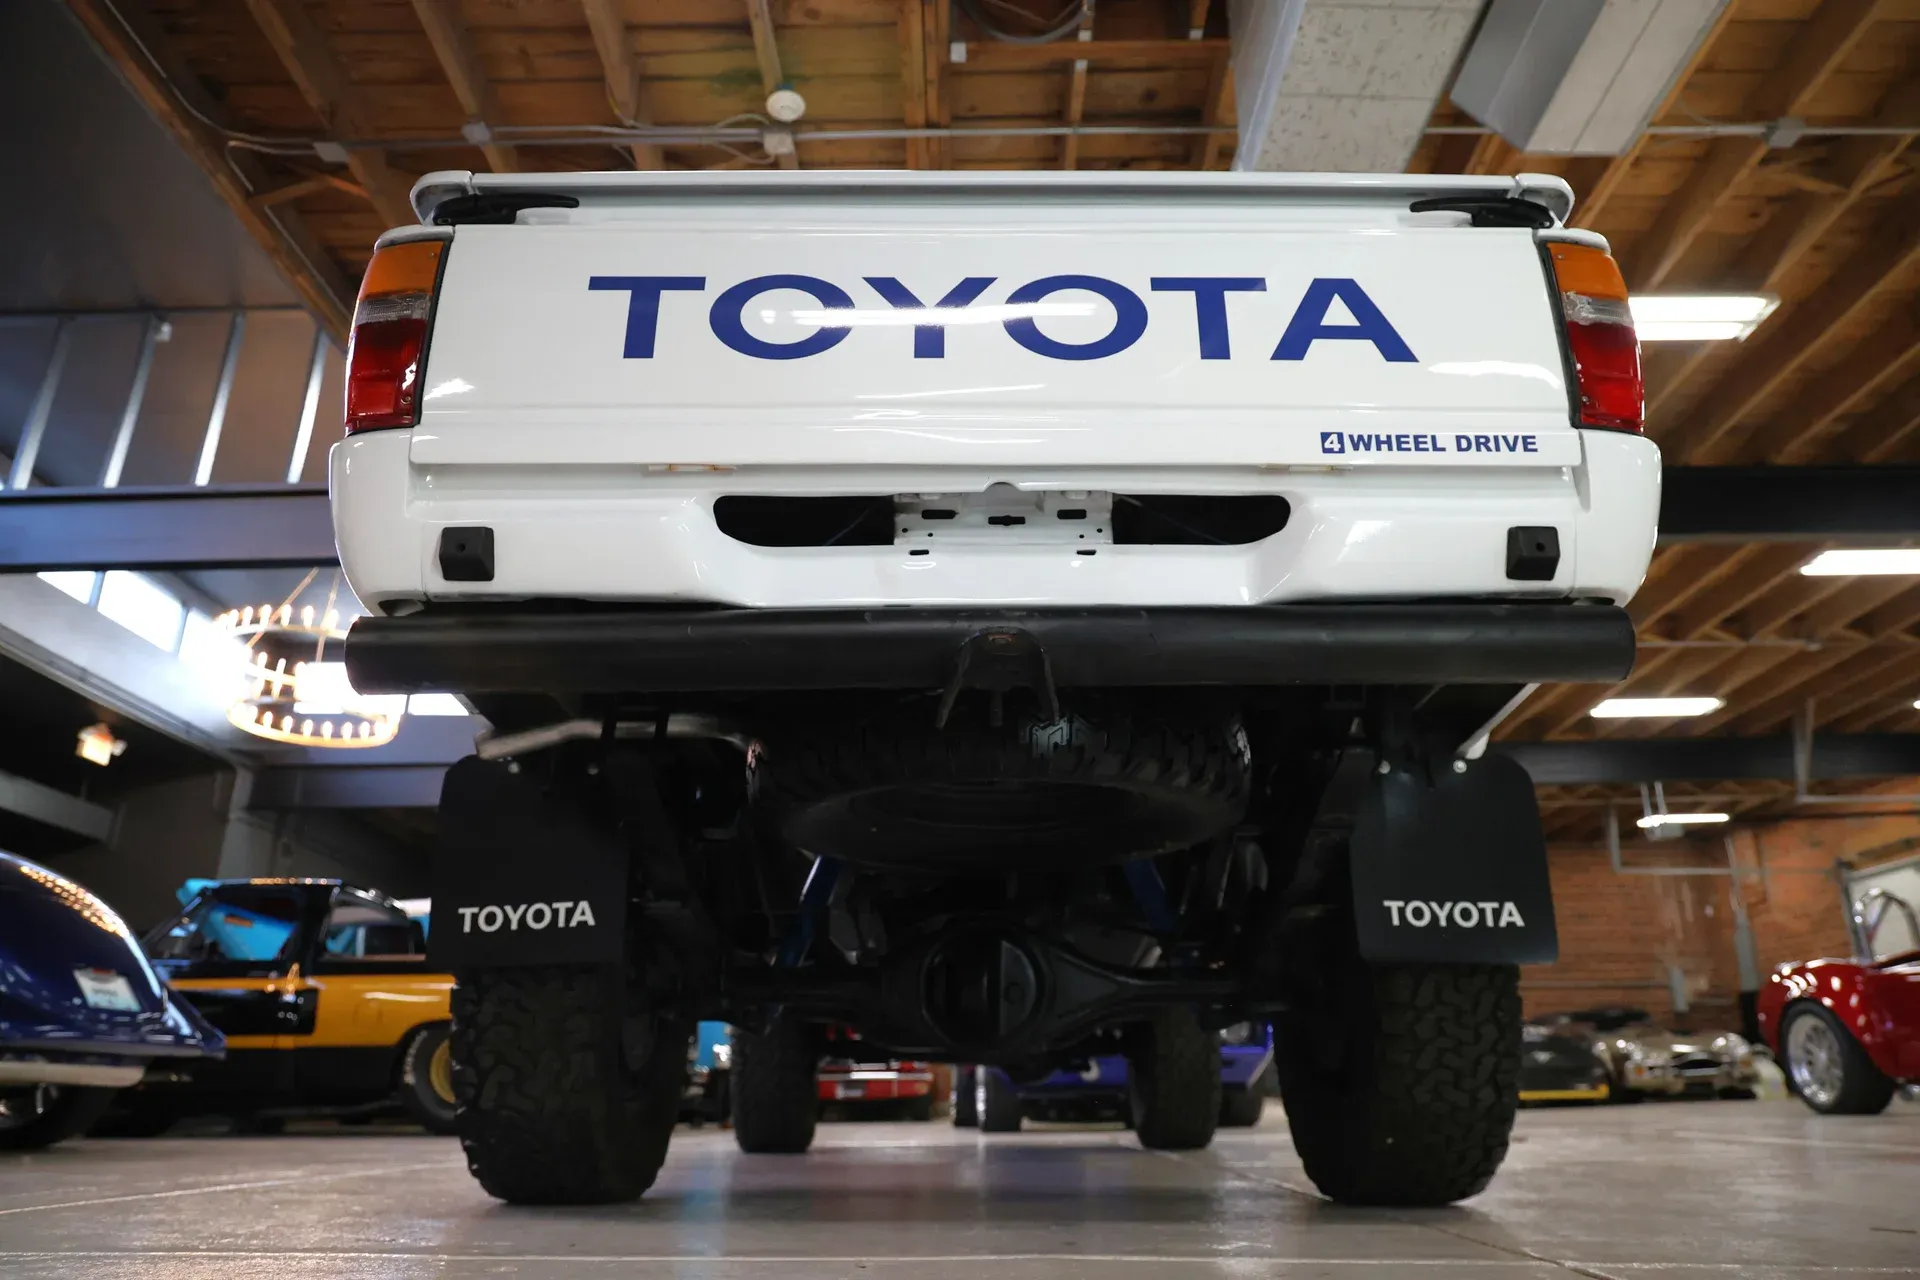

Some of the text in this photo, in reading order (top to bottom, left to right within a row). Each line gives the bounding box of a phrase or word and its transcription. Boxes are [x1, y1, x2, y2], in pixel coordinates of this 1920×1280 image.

[588, 273, 1418, 362] TOYOTA
[1455, 434, 1538, 453] DRIVE
[457, 900, 596, 934] TOYOTA
[1382, 899, 1526, 929] TOYOTA
